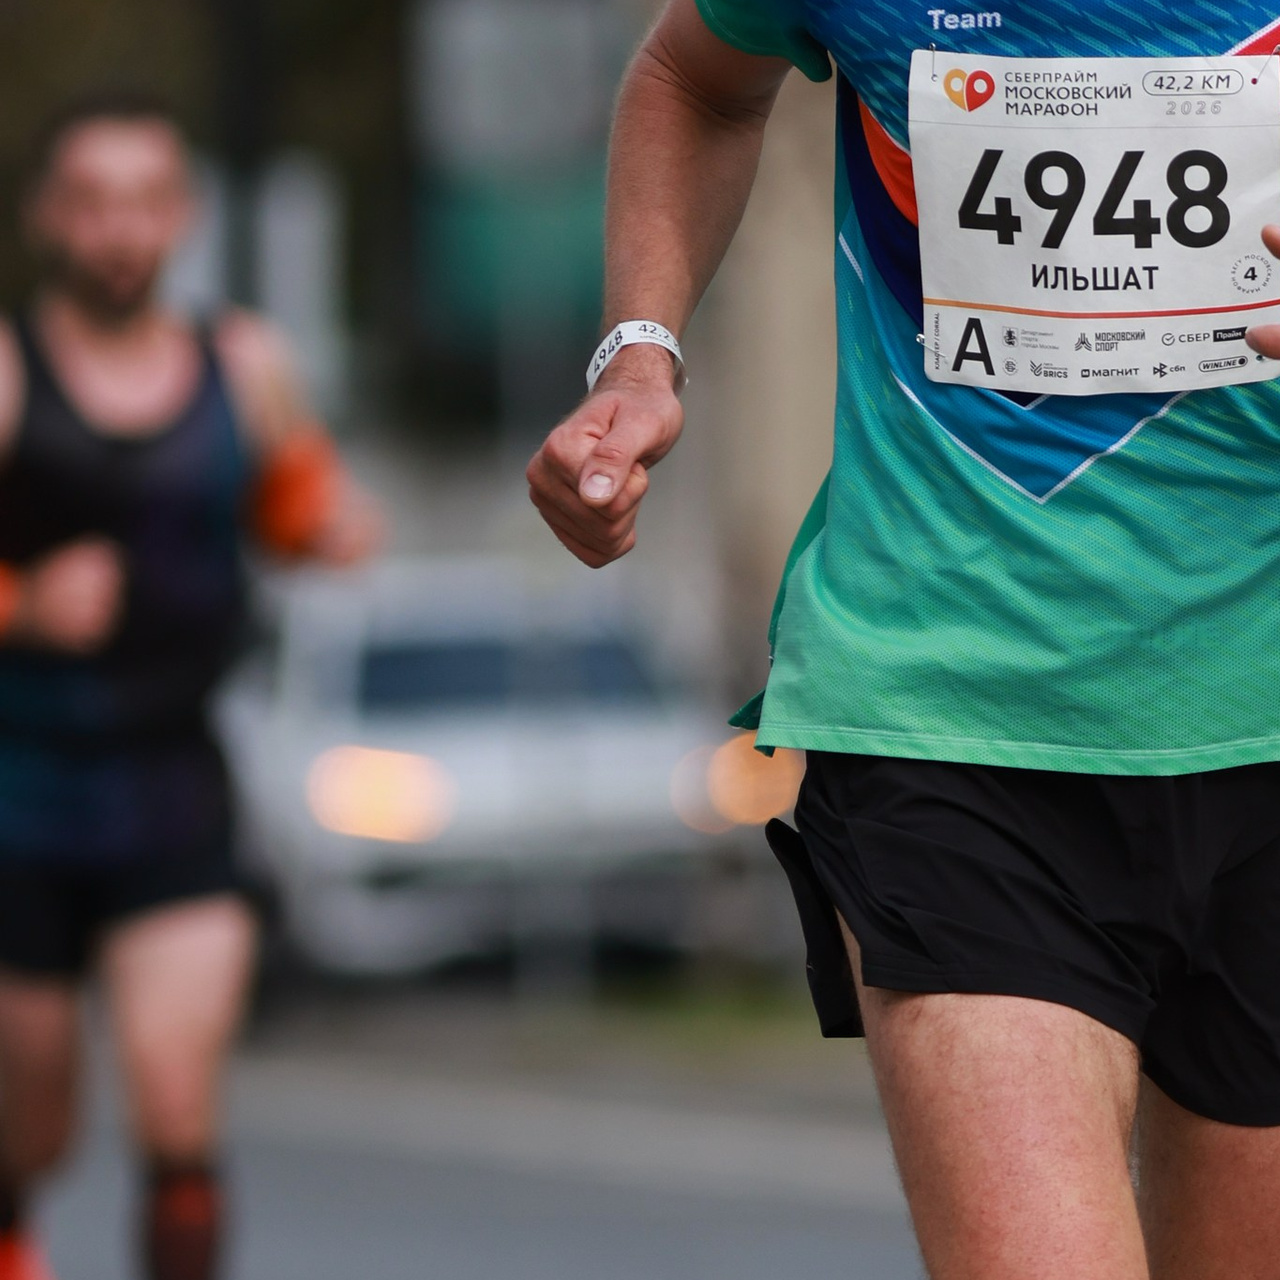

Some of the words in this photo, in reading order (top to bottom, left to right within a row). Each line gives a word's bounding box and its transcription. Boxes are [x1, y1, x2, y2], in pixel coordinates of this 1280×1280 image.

[927, 9, 1002, 31] Team
[1004, 71, 1098, 83] СБЕРПРАЙМ
[1153, 75, 1194, 92] 42,2
[1004, 83, 1132, 100] МОСКОВСКИЙ
[1005, 102, 1099, 117] МАРАФОН
[1165, 100, 1222, 115] 2026
[957, 148, 1231, 250] 4948
[1030, 263, 1159, 291] ИЛЬШАТ
[1244, 266, 1258, 281] 4
[1094, 328, 1146, 342] МОСКОВСКИЙ
[1178, 332, 1211, 343] СБЕР
[594, 330, 623, 373] 4948
[1094, 341, 1119, 352] СПОРТ
[1202, 359, 1237, 370] WINLINE
[1043, 370, 1068, 379] BRICS
